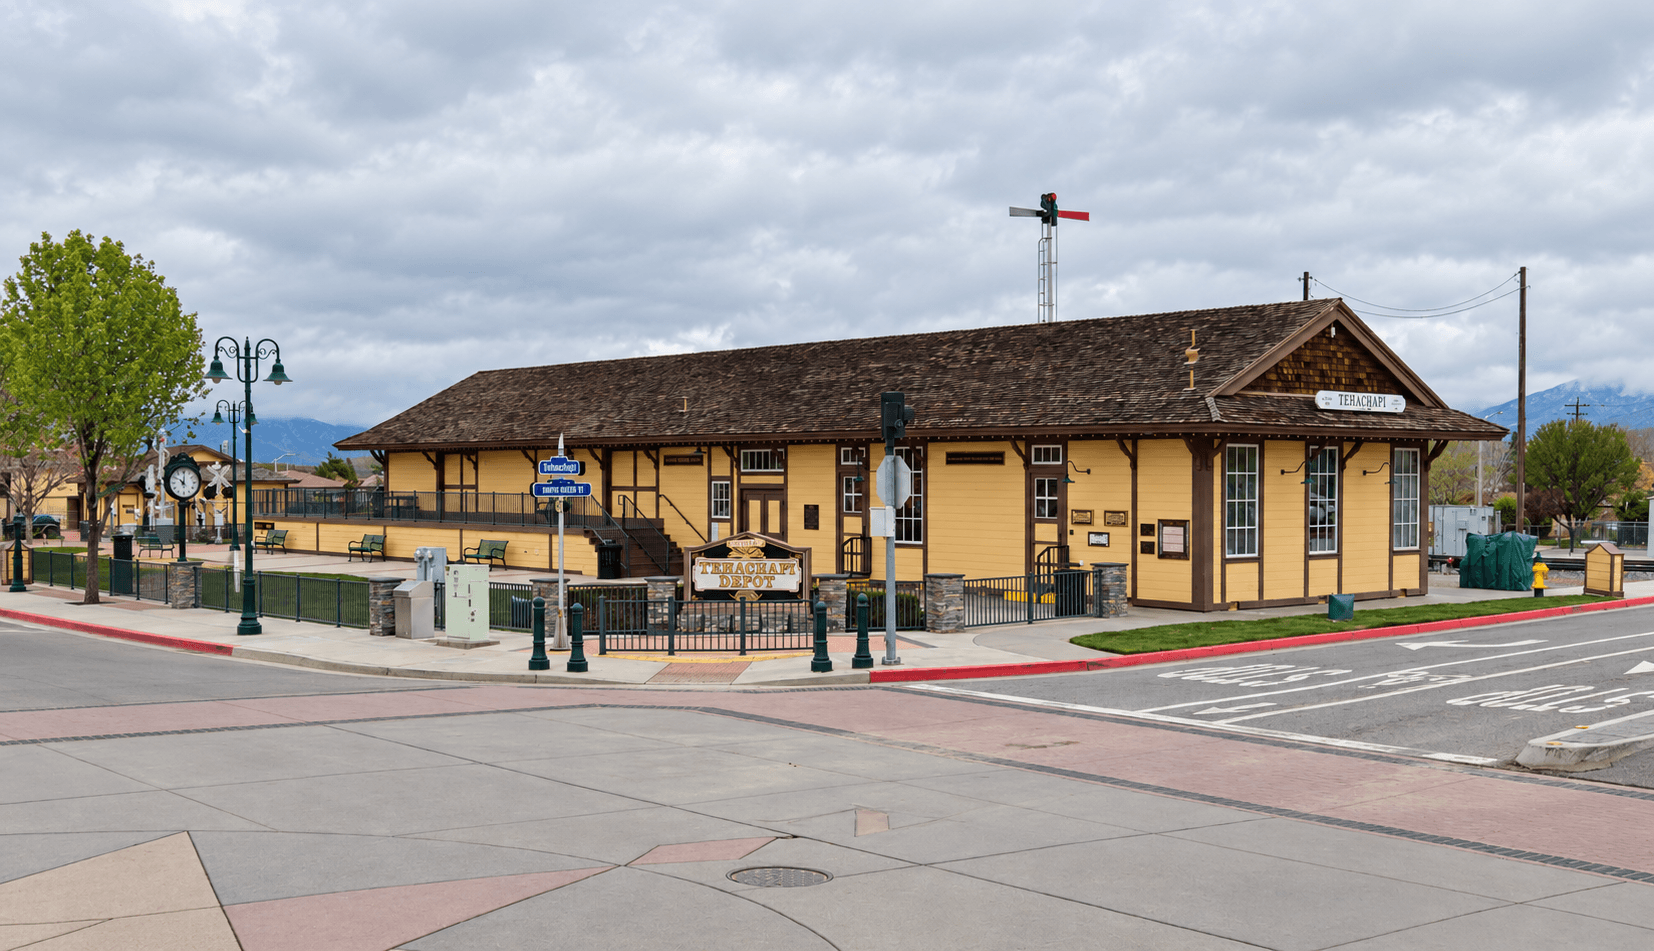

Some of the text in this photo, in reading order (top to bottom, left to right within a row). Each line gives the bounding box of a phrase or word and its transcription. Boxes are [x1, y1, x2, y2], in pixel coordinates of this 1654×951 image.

[1338, 394, 1386, 408] TEHACHAPI
[699, 561, 796, 575] TEHACHAPI
[719, 575, 775, 588] DEPOT
